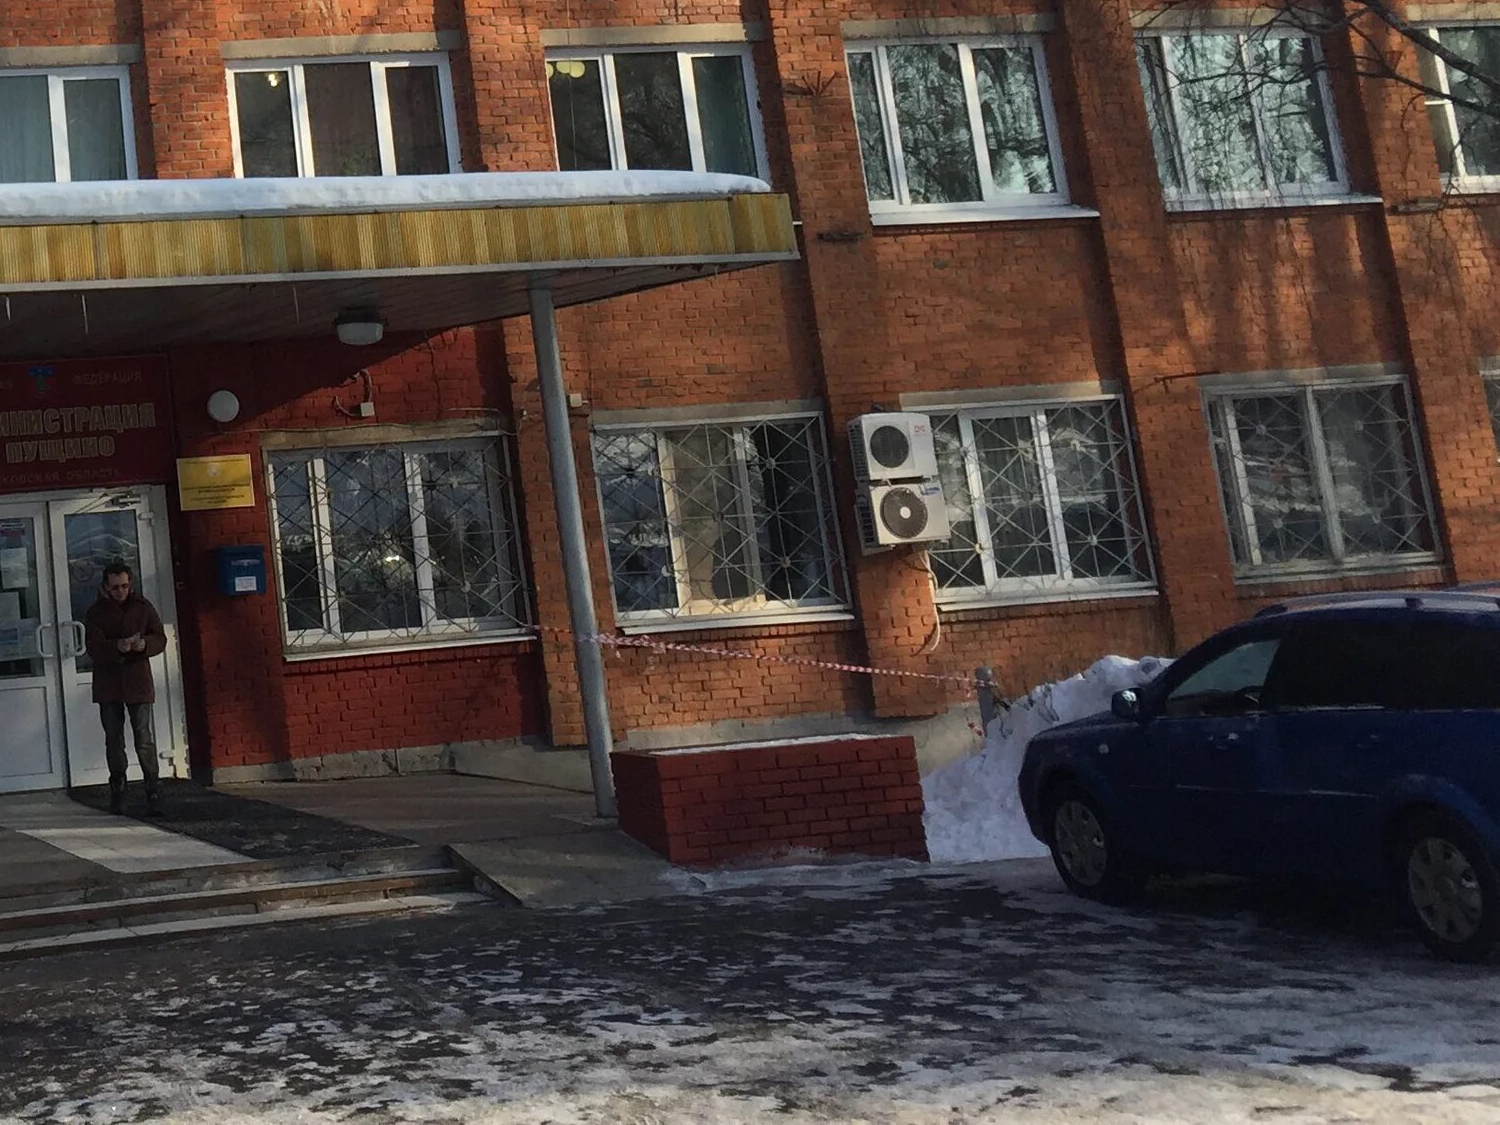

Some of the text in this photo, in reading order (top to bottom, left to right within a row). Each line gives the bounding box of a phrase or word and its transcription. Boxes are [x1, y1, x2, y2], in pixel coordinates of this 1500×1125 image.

[72, 370, 143, 386] ФЕДЕРАЦИЯ
[5, 435, 116, 463] ПУЩИНО
[68, 468, 122, 481] ОБЛАСТЬ
